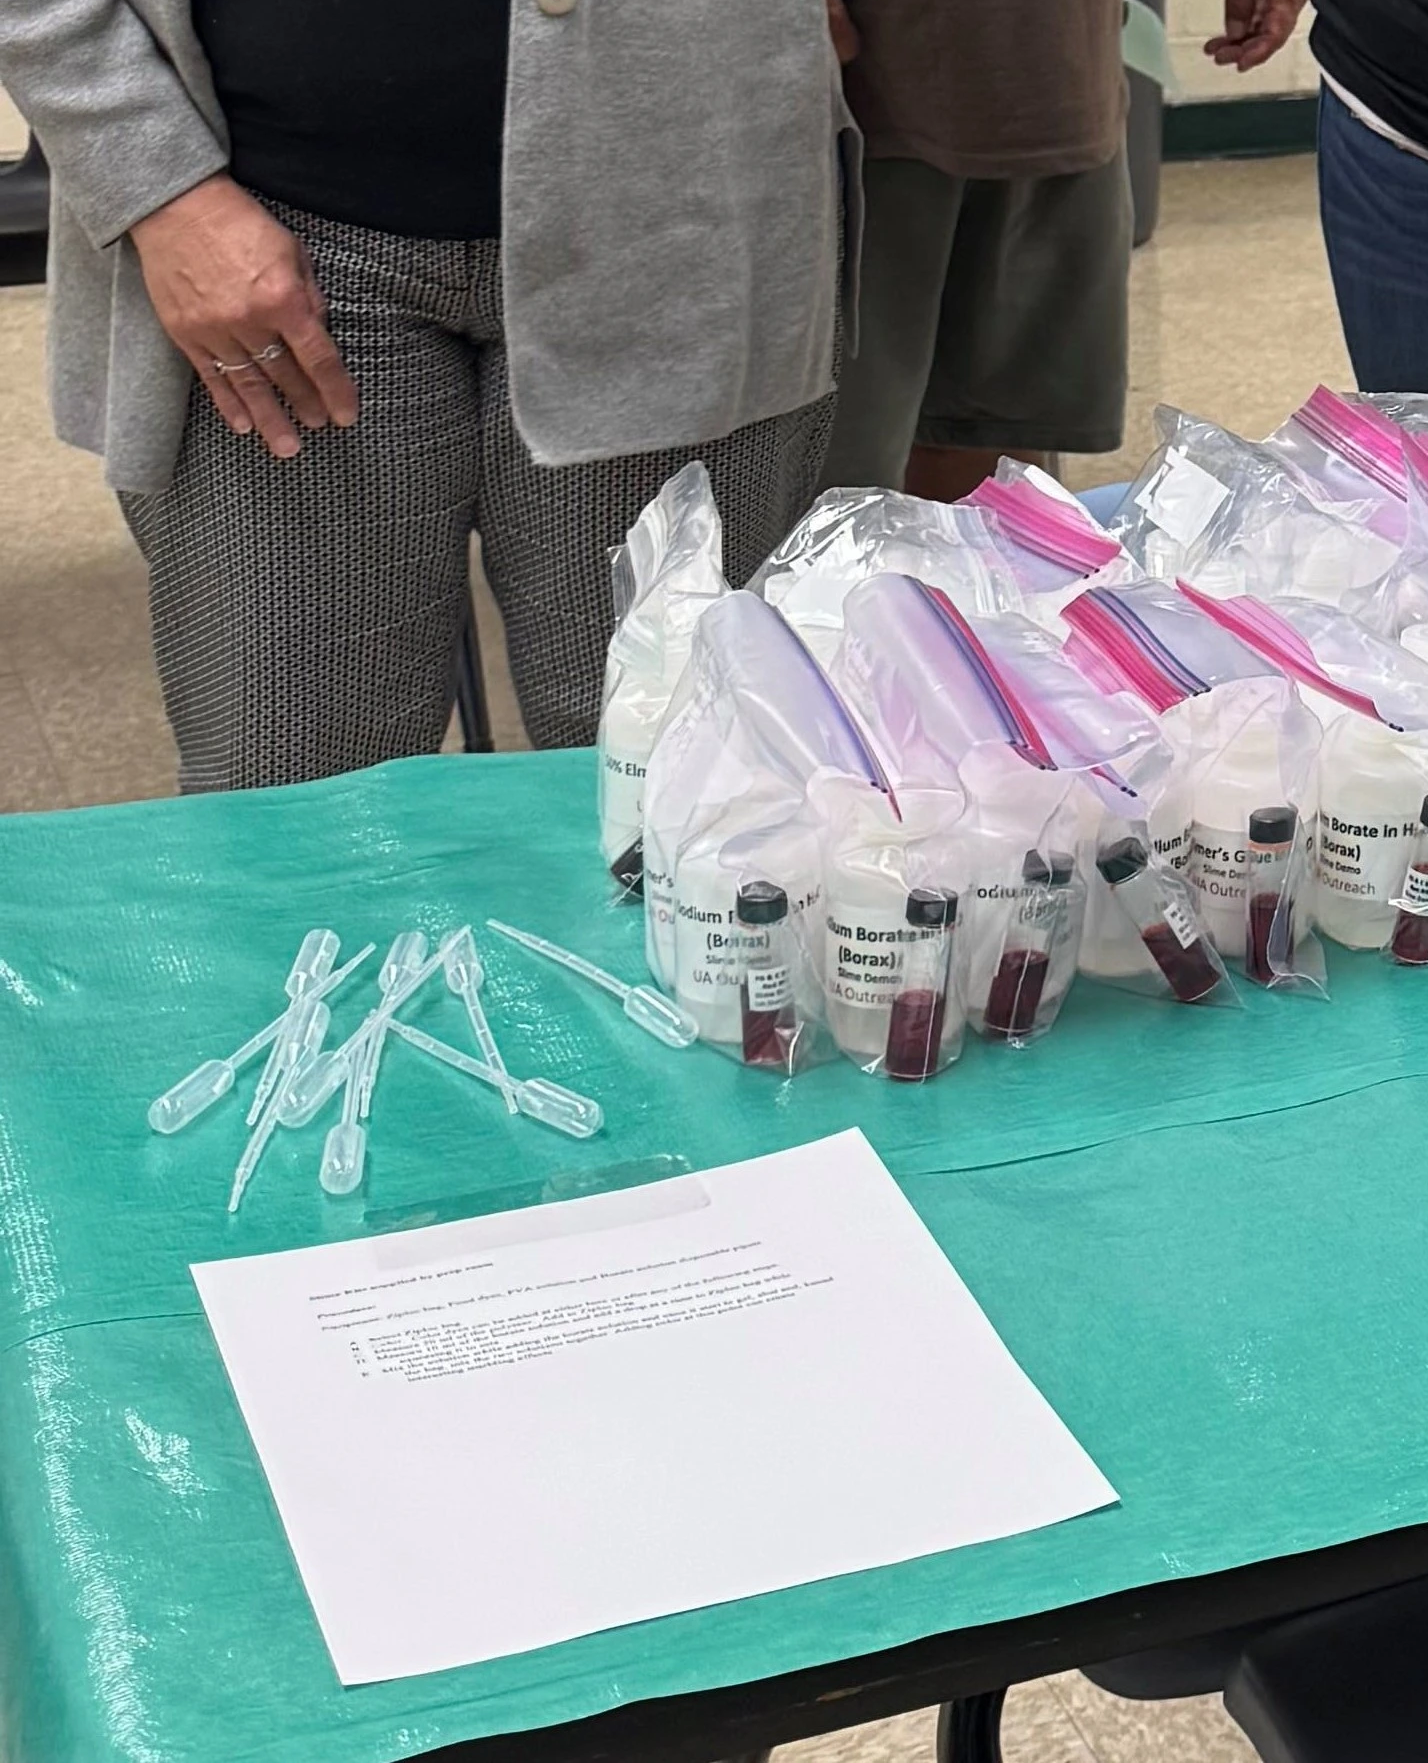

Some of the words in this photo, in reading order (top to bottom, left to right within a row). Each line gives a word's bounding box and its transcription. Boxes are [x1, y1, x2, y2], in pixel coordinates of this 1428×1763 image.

[1332, 817, 1378, 838] Borate
[1384, 825, 1398, 837] in
[839, 945, 895, 970] (Borax)
